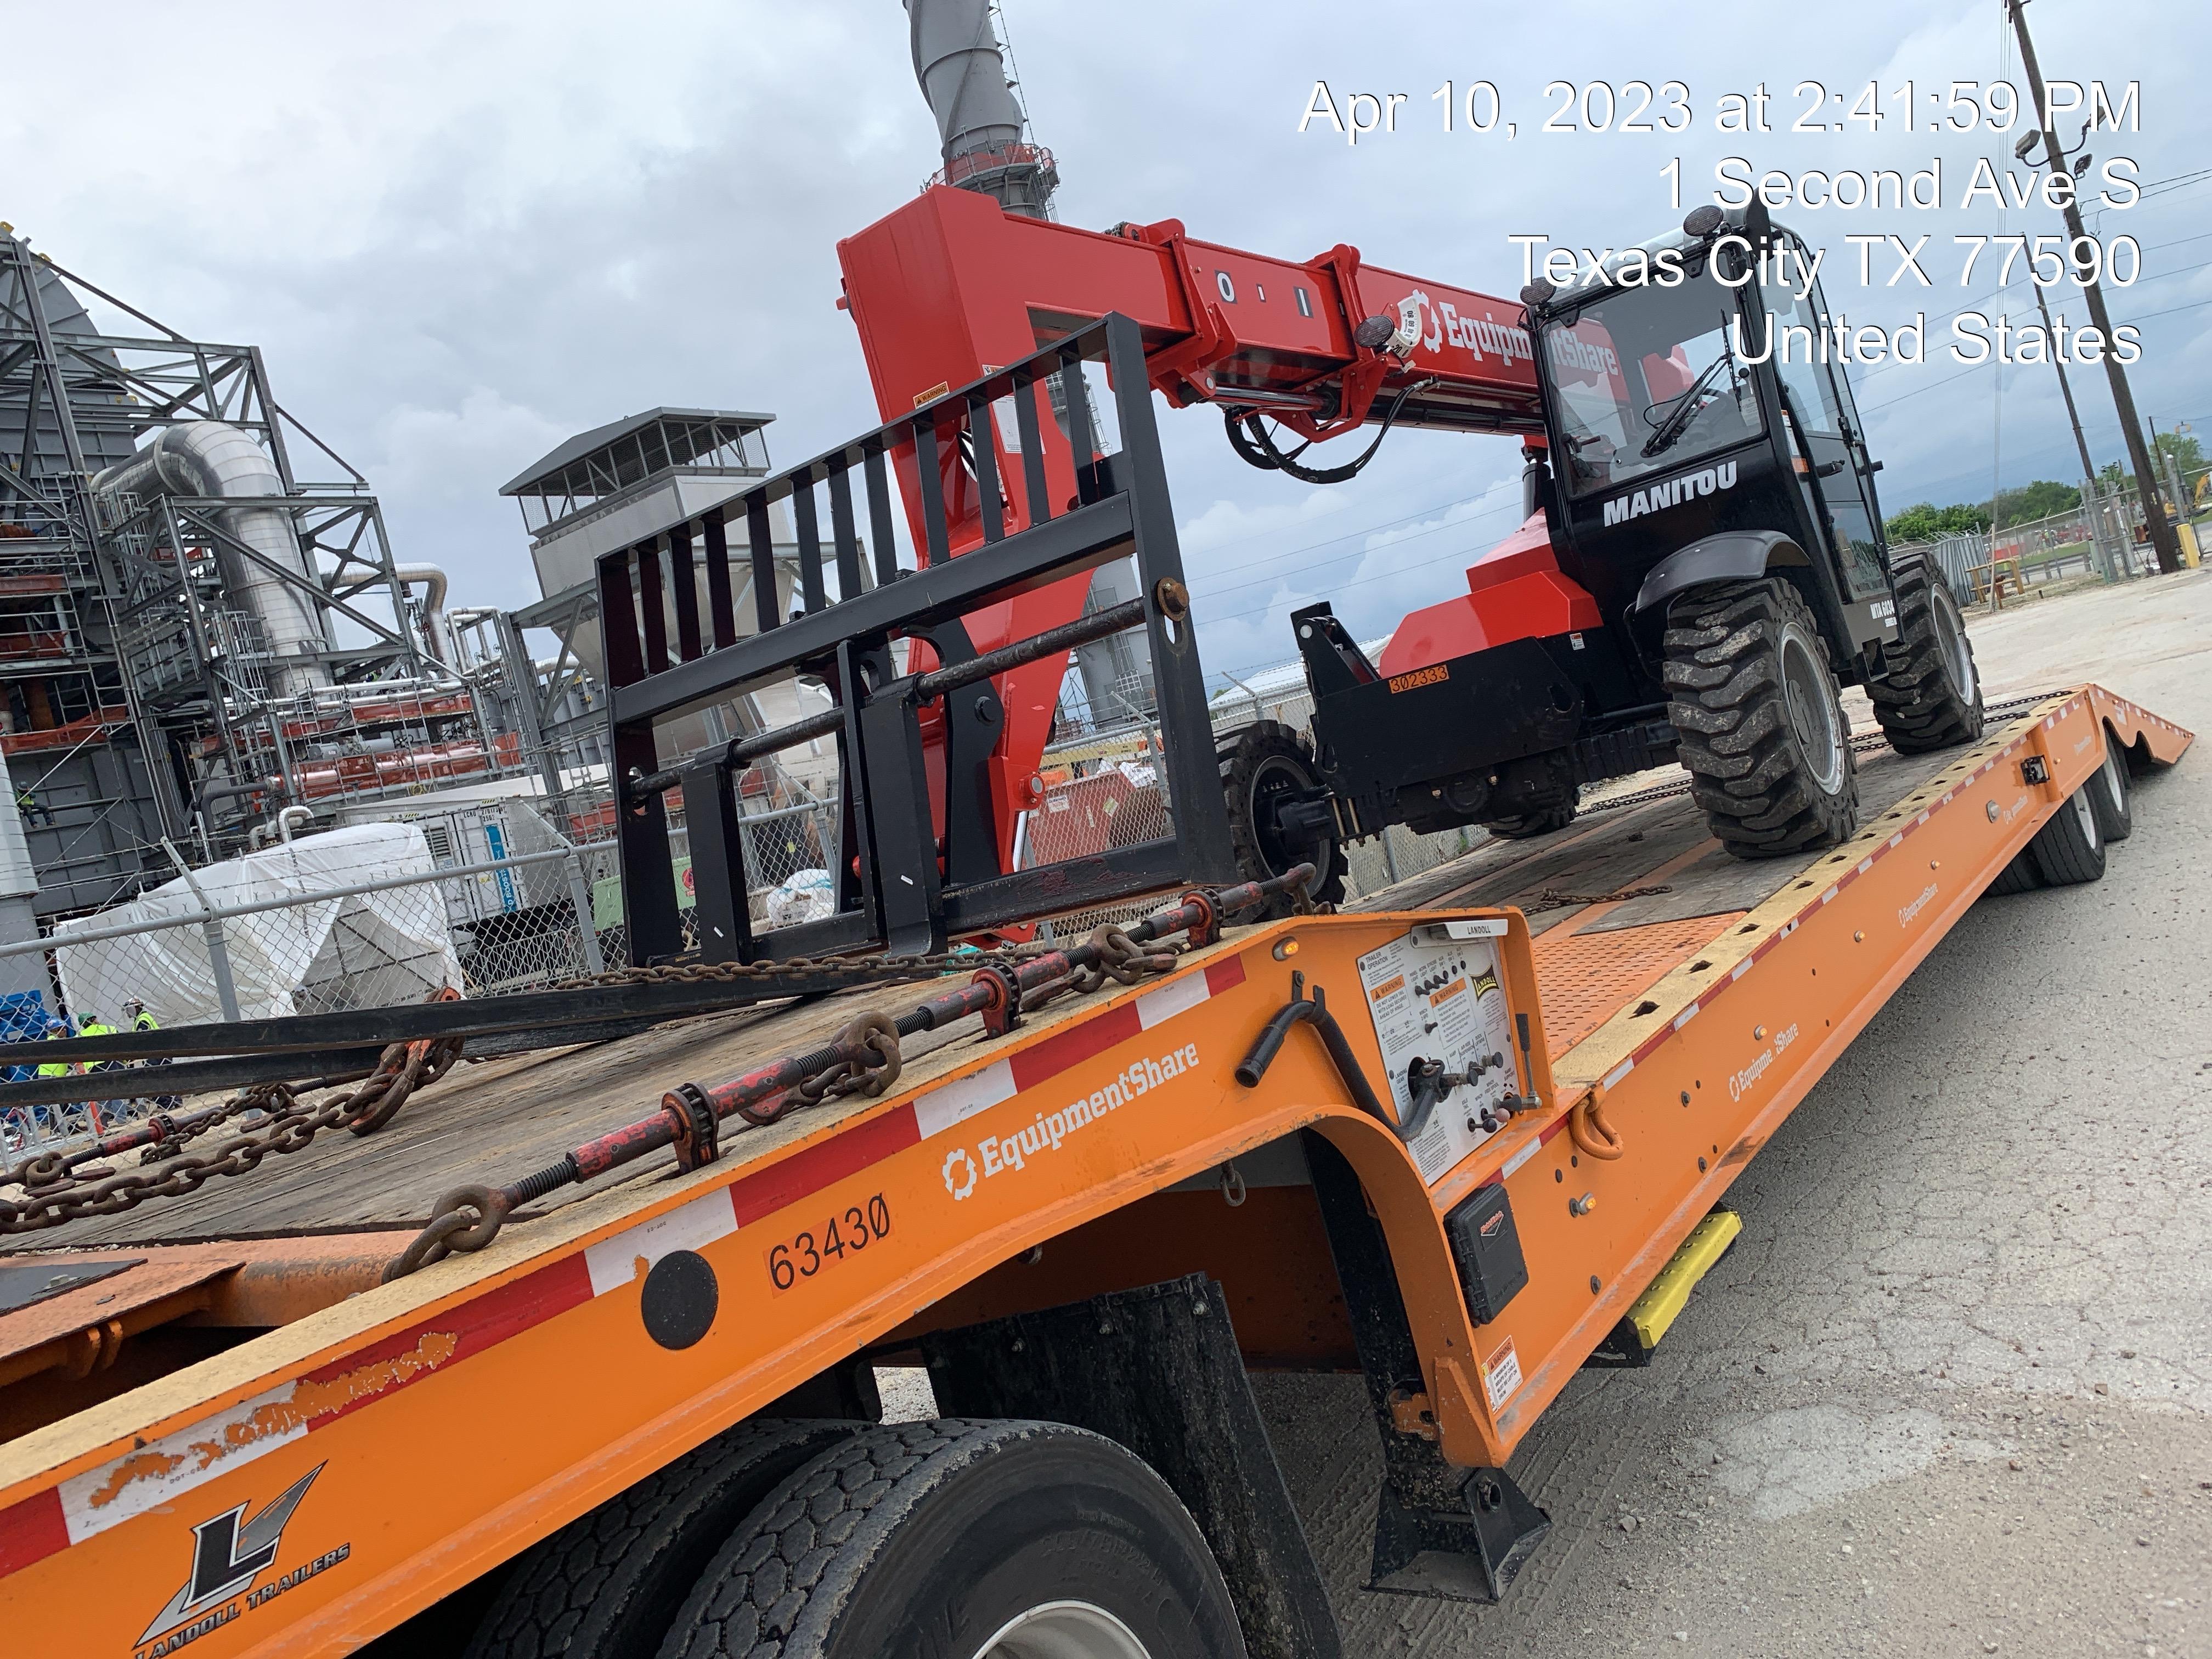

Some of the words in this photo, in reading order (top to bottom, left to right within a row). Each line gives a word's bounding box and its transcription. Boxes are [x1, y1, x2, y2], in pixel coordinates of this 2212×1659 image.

[922, 386, 946, 400] WARNING
[1603, 460, 1737, 527] MANITOU
[1391, 666, 1447, 692] 302333
[1467, 926, 1491, 934] LANDOLL
[1365, 952, 1381, 963] TRAILER
[1367, 956, 1389, 969] OPERATION
[1380, 978, 1402, 994] WARNING
[1473, 977, 1497, 997] LANDOLL
[977, 1042, 1200, 1179] EquipmentShare
[769, 1194, 891, 1290] 63430
[1493, 1342, 1512, 1365] WARNING
[245, 1542, 351, 1611] TRAILERS
